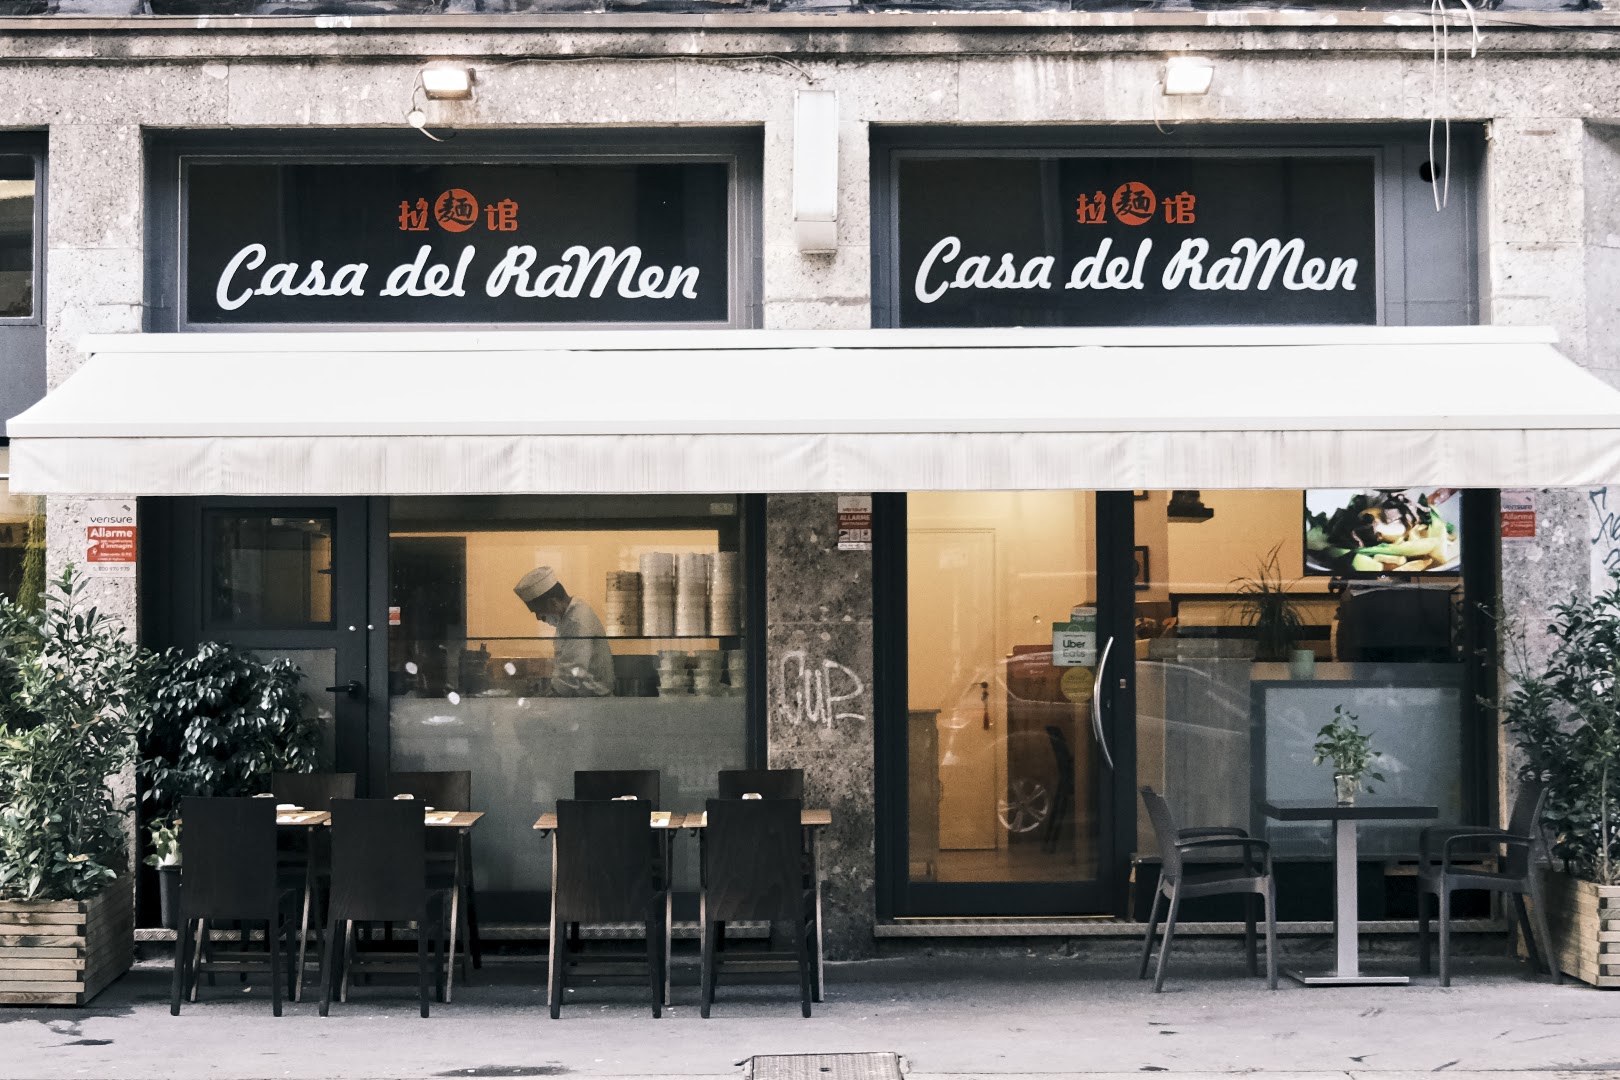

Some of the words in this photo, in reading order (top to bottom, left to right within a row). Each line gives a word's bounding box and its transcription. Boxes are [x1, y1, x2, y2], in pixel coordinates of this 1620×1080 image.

[914, 236, 1056, 304] Casa
[1064, 237, 1153, 290] del
[1161, 237, 1359, 291] RaMen
[215, 243, 369, 311] Casa
[379, 244, 476, 298] del
[485, 244, 700, 300] RaMen
[90, 527, 133, 538] Allarme
[1062, 639, 1086, 649] Uber
[1062, 649, 1086, 658] Eats
